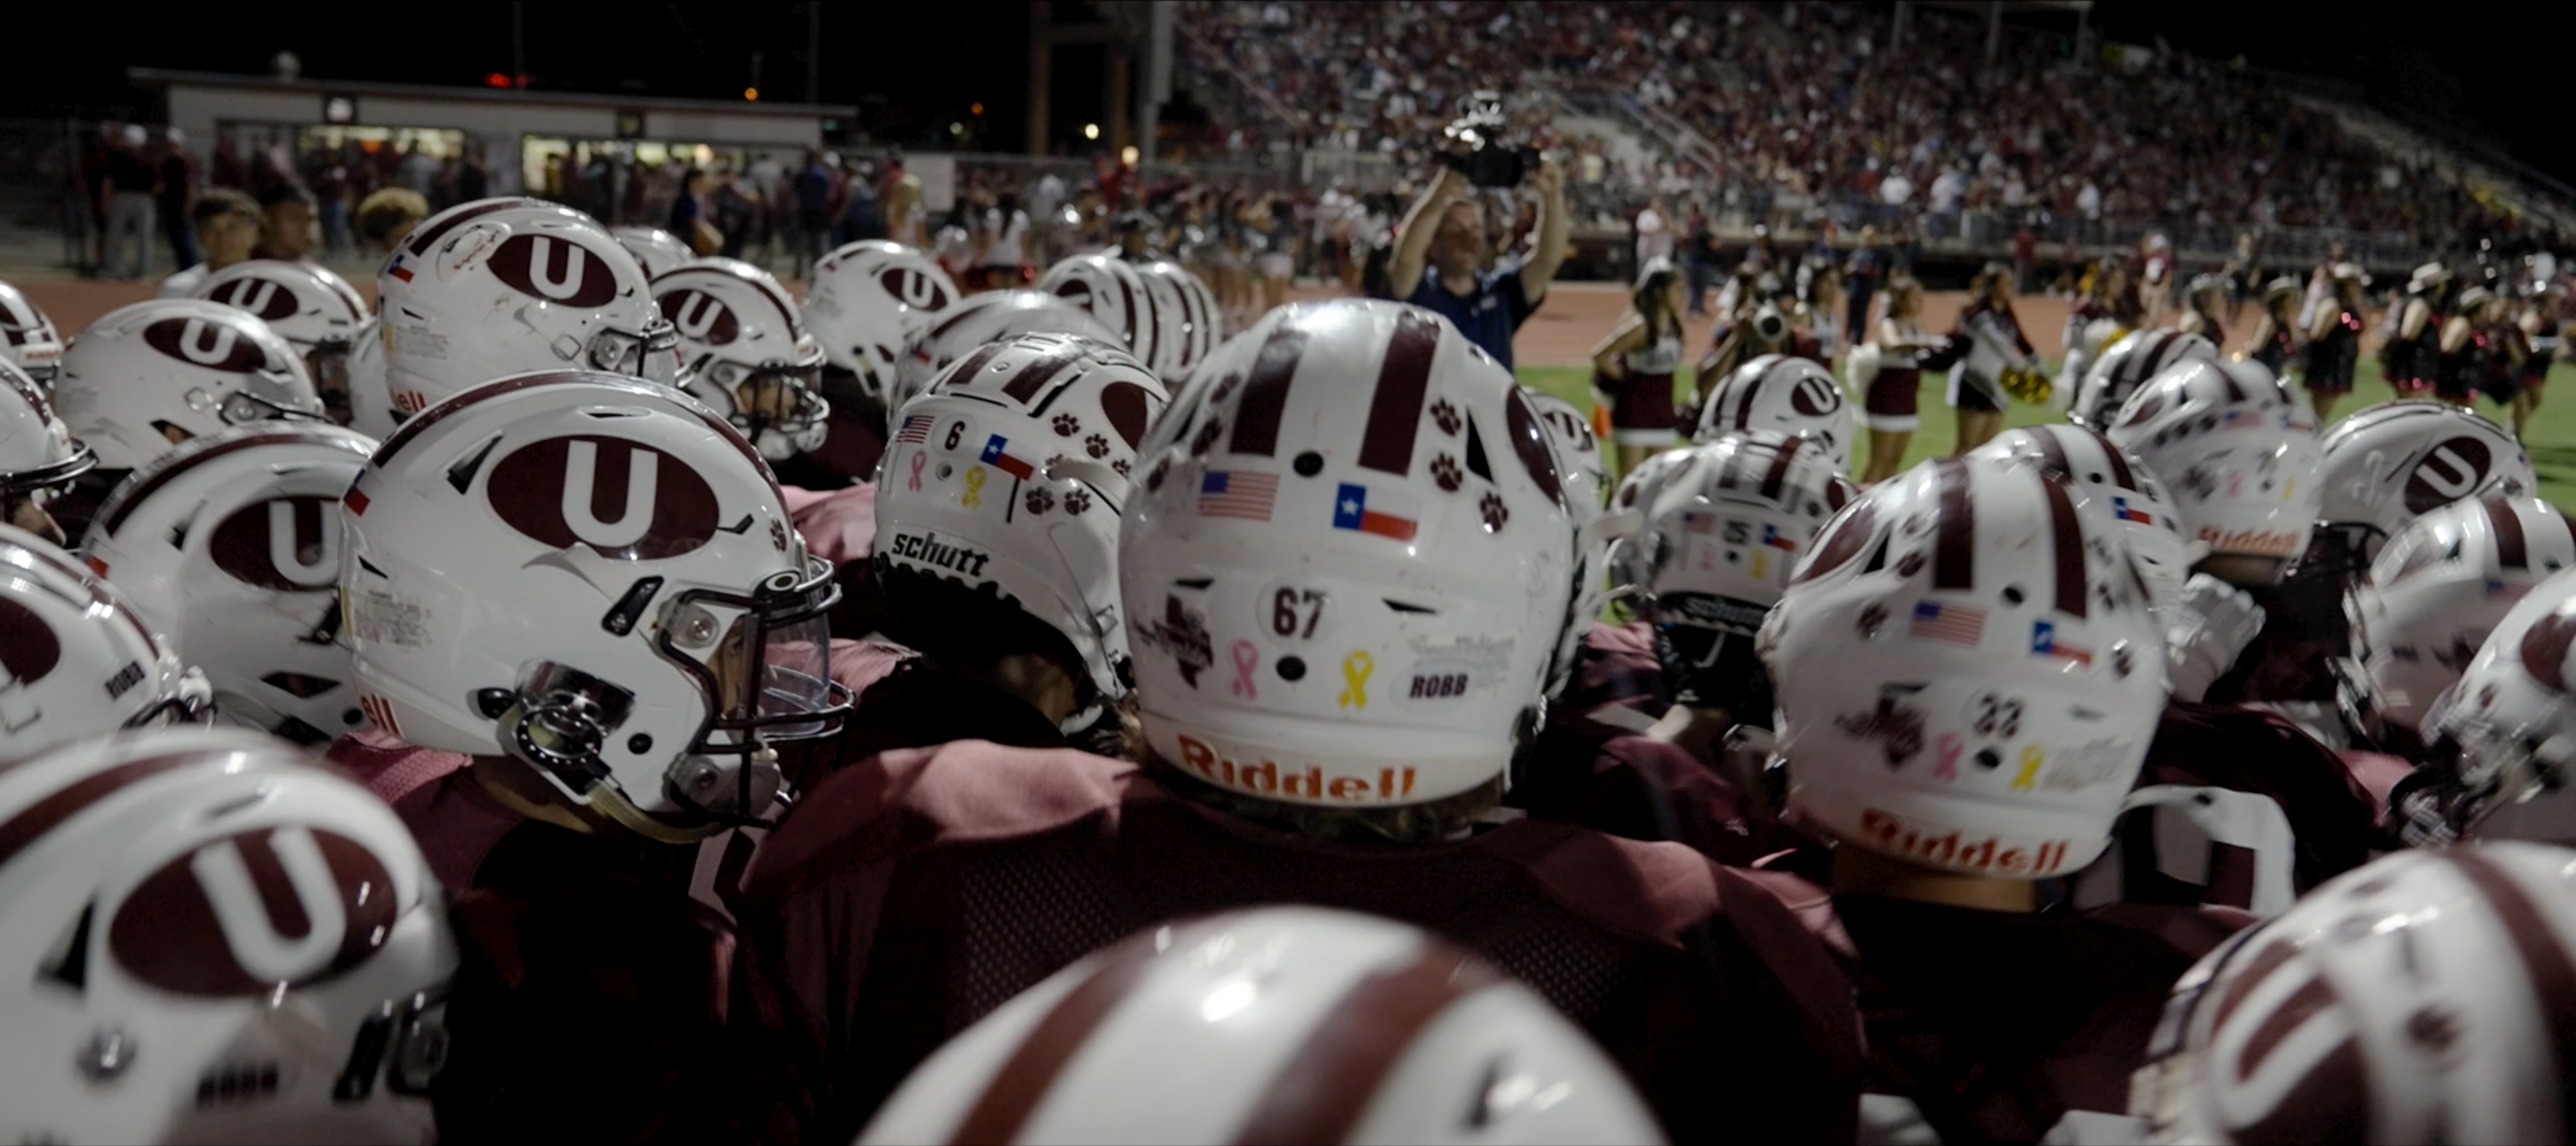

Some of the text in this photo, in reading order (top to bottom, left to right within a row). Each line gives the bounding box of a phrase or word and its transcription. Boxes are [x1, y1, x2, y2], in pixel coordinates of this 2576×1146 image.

[529, 236, 585, 299] U
[902, 268, 934, 309] U
[229, 278, 279, 316] U
[676, 291, 724, 338] U
[180, 319, 237, 364] U
[1801, 377, 1835, 414] U
[944, 420, 966, 451] 6
[562, 440, 658, 548] U
[2414, 444, 2477, 499] U
[270, 499, 341, 587] U
[892, 533, 989, 578] schutt
[1273, 587, 1328, 640] 67
[1409, 673, 1468, 699] ROBB
[1177, 735, 1417, 800] Riddell
[1859, 809, 2070, 872] Riddell
[192, 828, 347, 985] U
[2210, 953, 2357, 1133] U
